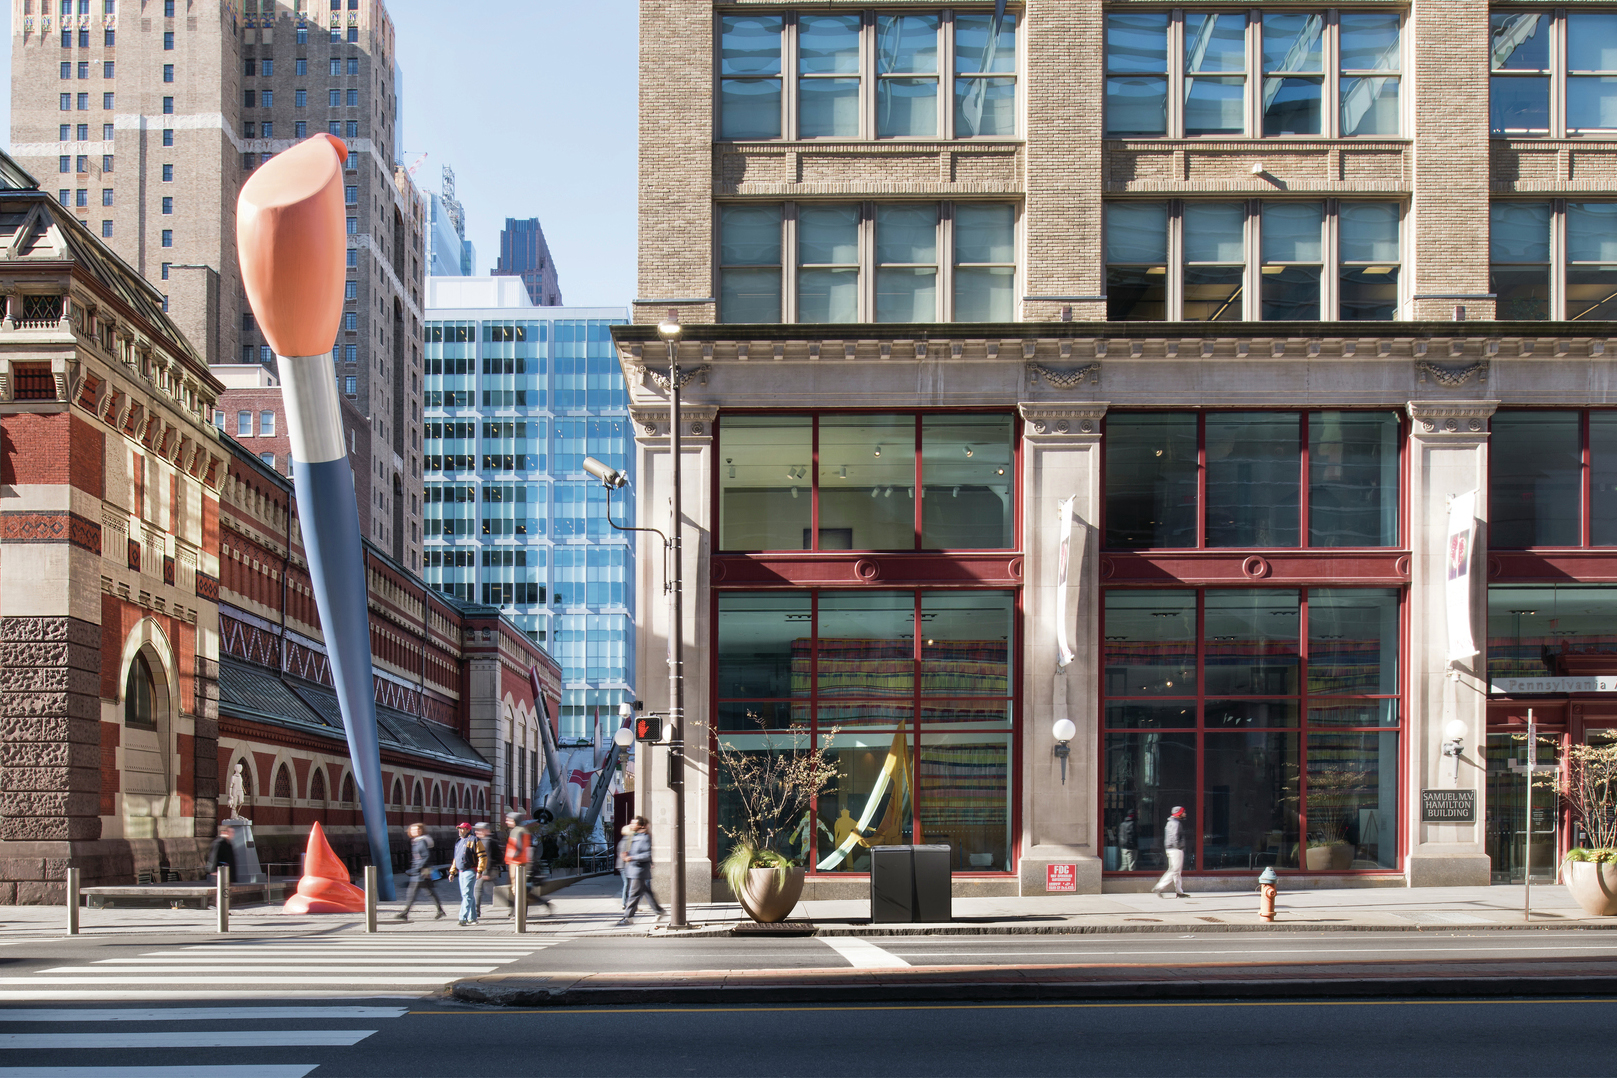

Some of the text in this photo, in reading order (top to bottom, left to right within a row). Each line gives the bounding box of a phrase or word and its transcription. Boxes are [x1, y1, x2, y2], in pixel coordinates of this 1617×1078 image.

[1509, 679, 1607, 692] Pennsylvania
[1423, 793, 1458, 801] SAMUEL
[1425, 801, 1471, 809] HAMILTON
[1427, 809, 1469, 817] BUILDING
[1053, 865, 1070, 874] FDC
